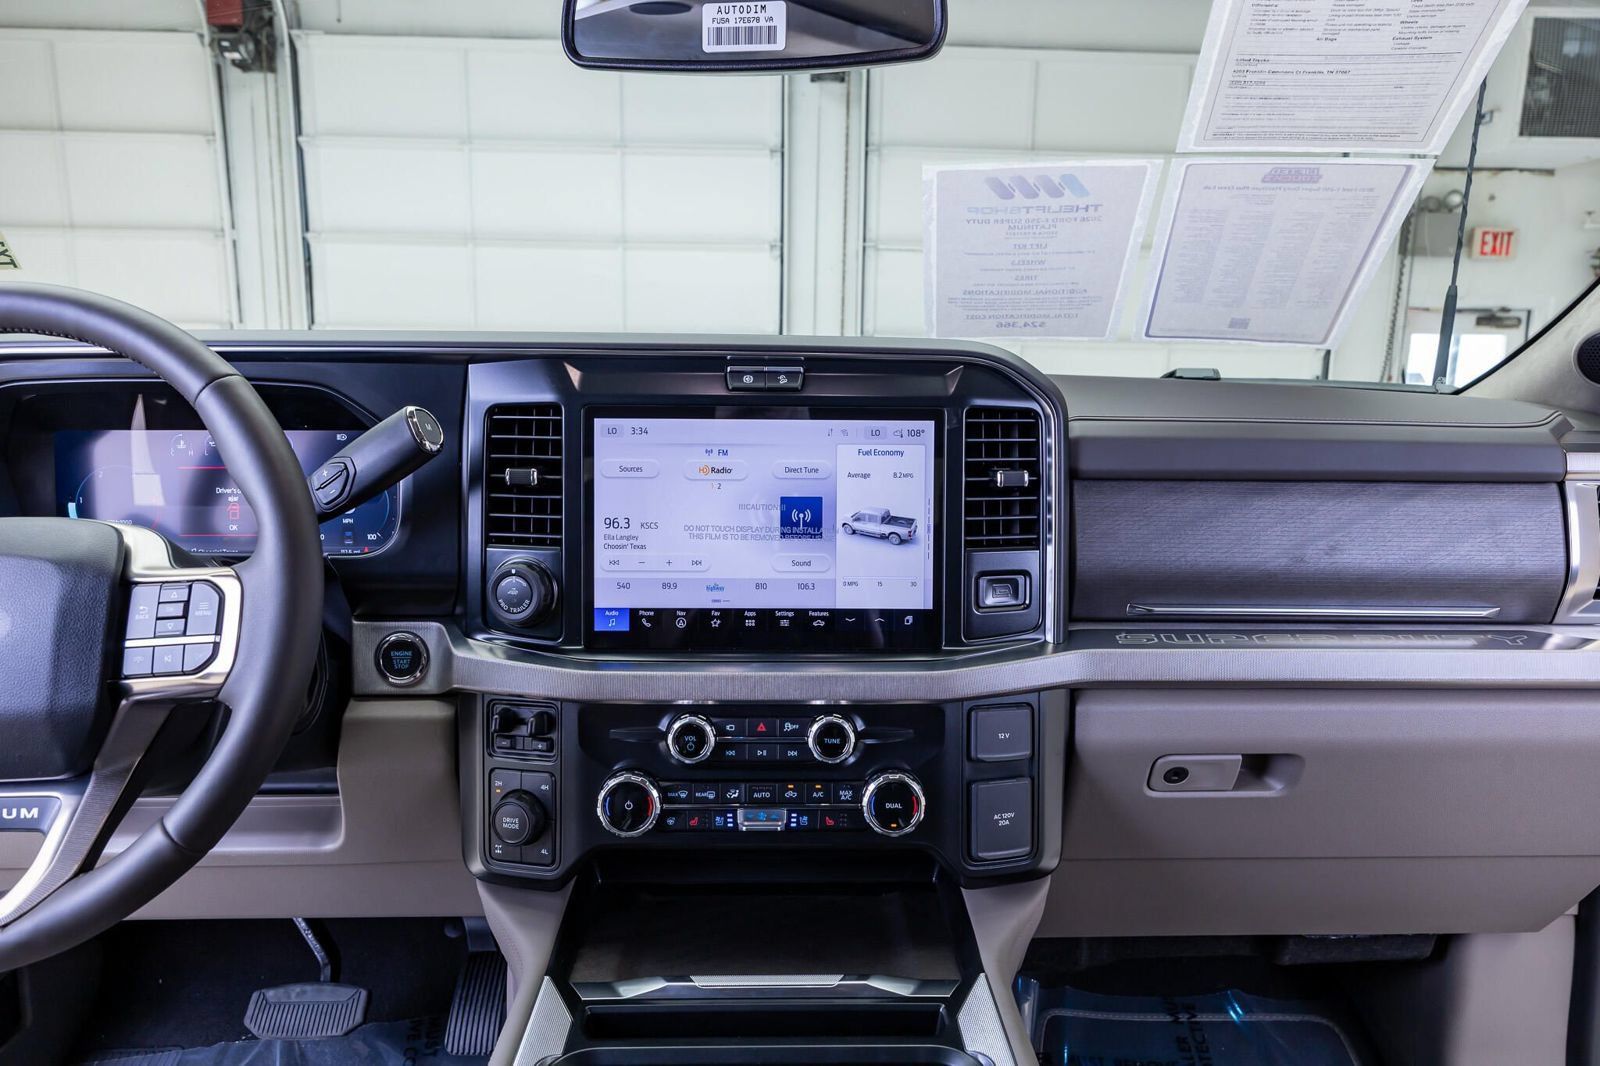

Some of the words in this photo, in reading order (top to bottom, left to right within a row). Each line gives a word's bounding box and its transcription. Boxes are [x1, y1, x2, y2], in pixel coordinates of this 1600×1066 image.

[716, 5, 767, 15] AUTODIM
[1480, 231, 1515, 256] EXIT
[607, 427, 617, 435] LO
[630, 426, 649, 436] 3:34
[870, 429, 881, 437] LO
[906, 428, 926, 438] 108°
[857, 448, 873, 456] Fuel
[873, 448, 905, 458] Economy
[618, 465, 643, 473] Sources
[711, 466, 733, 474] Radio
[784, 466, 803, 474] Direct
[803, 466, 820, 474] Tune
[847, 472, 871, 480] Average
[603, 517, 631, 530] 96.3
[640, 521, 659, 530] KSCS
[711, 525, 735, 533] TOUCH
[735, 526, 764, 534] DISPLAY
[765, 526, 792, 534] DURING
[603, 533, 615, 541] Ella
[615, 533, 639, 542] Langley
[603, 542, 629, 550] Choosin'
[629, 542, 647, 550] Texas
[791, 559, 812, 567] Sound
[616, 582, 631, 590] 540
[661, 582, 678, 590] 89.9
[754, 582, 768, 590] 810
[797, 582, 816, 591] 106.3
[498, 599, 509, 611] PRO
[510, 599, 531, 613] TRAILER
[774, 610, 795, 618] Settings
[2, 807, 39, 819] UM
